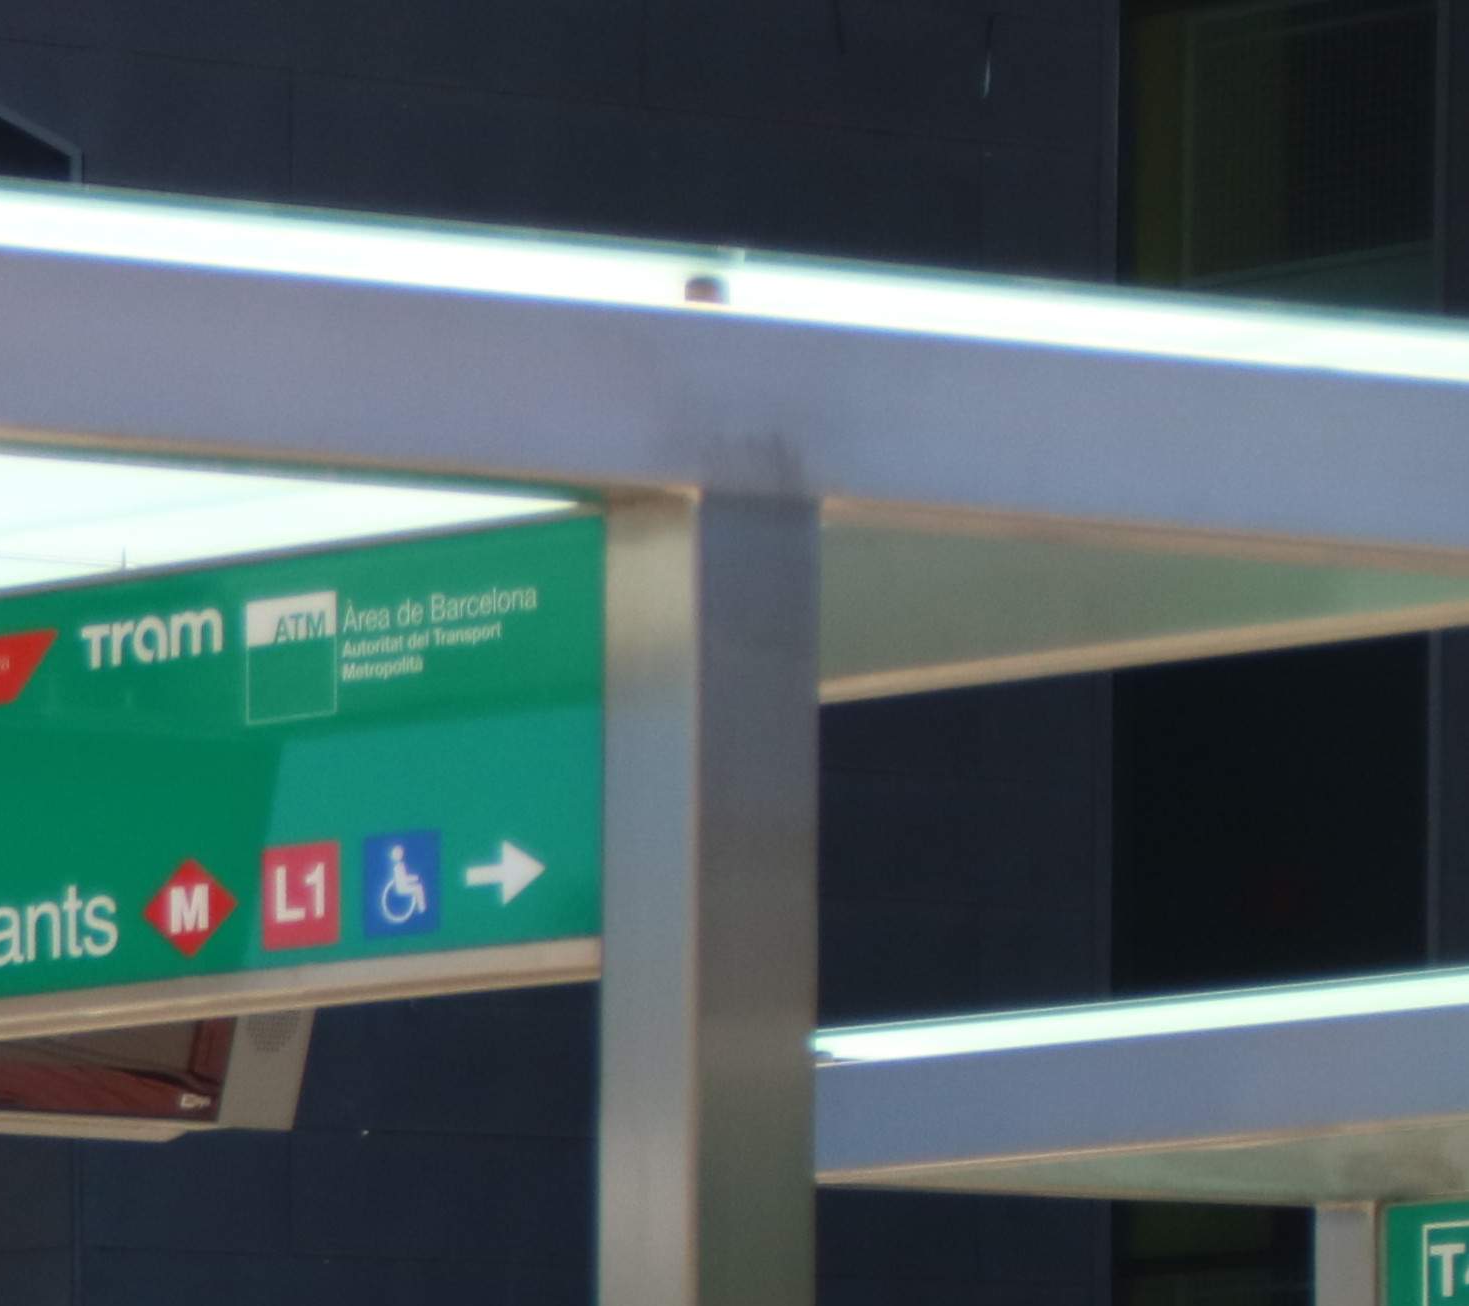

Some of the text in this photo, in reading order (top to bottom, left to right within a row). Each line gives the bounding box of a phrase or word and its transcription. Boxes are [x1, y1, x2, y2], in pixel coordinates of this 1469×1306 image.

[274, 611, 326, 643] ATM
[396, 599, 423, 626] de
[430, 587, 538, 623] Barcelona
[81, 608, 223, 670] Tram
[342, 621, 503, 658] Autoritat del Transport
[170, 884, 209, 934] M
[274, 863, 327, 922] L1
[1429, 1243, 1469, 1298] T
